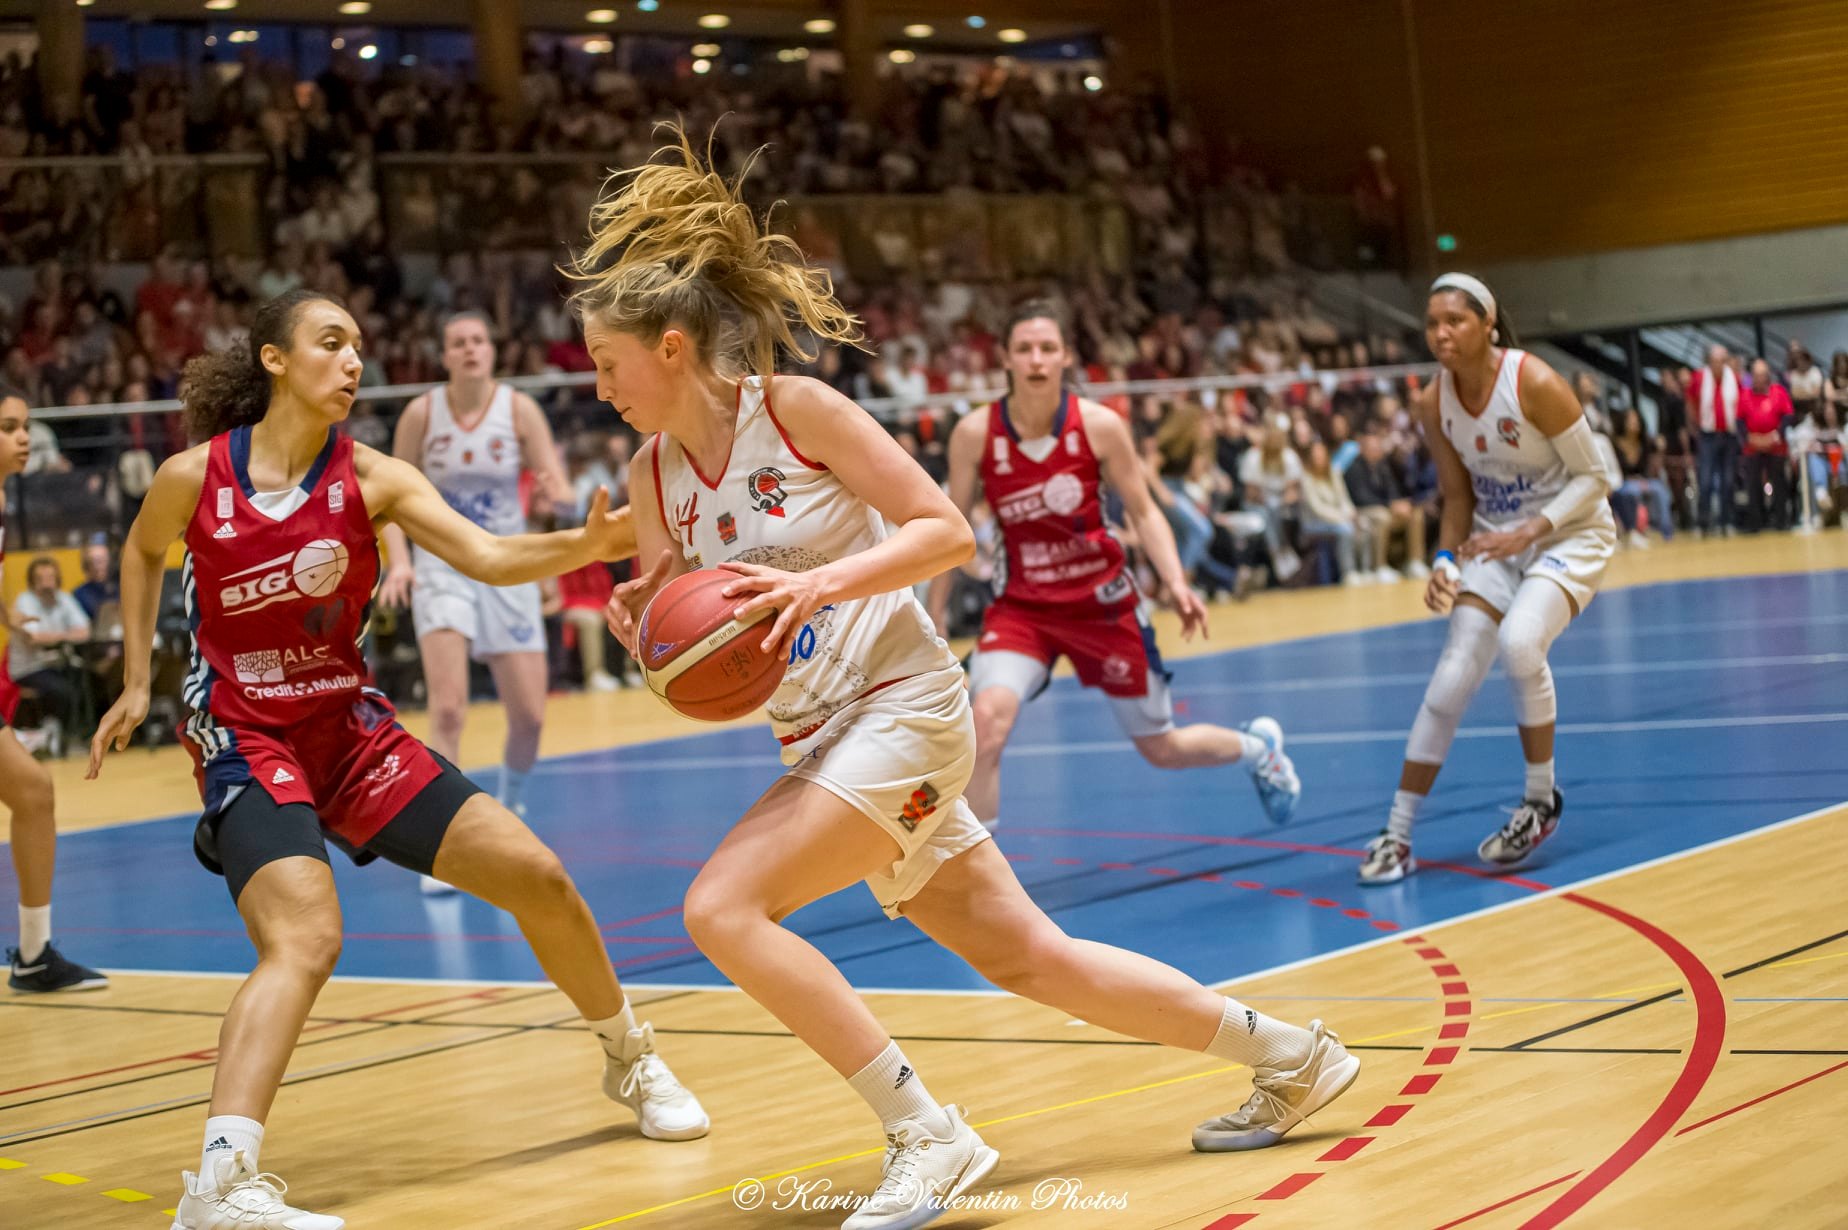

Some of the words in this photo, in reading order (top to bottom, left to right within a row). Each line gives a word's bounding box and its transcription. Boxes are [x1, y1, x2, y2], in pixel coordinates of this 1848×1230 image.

[329, 494, 342, 506] SIG
[220, 569, 292, 608] SIG
[283, 645, 330, 666] ALC
